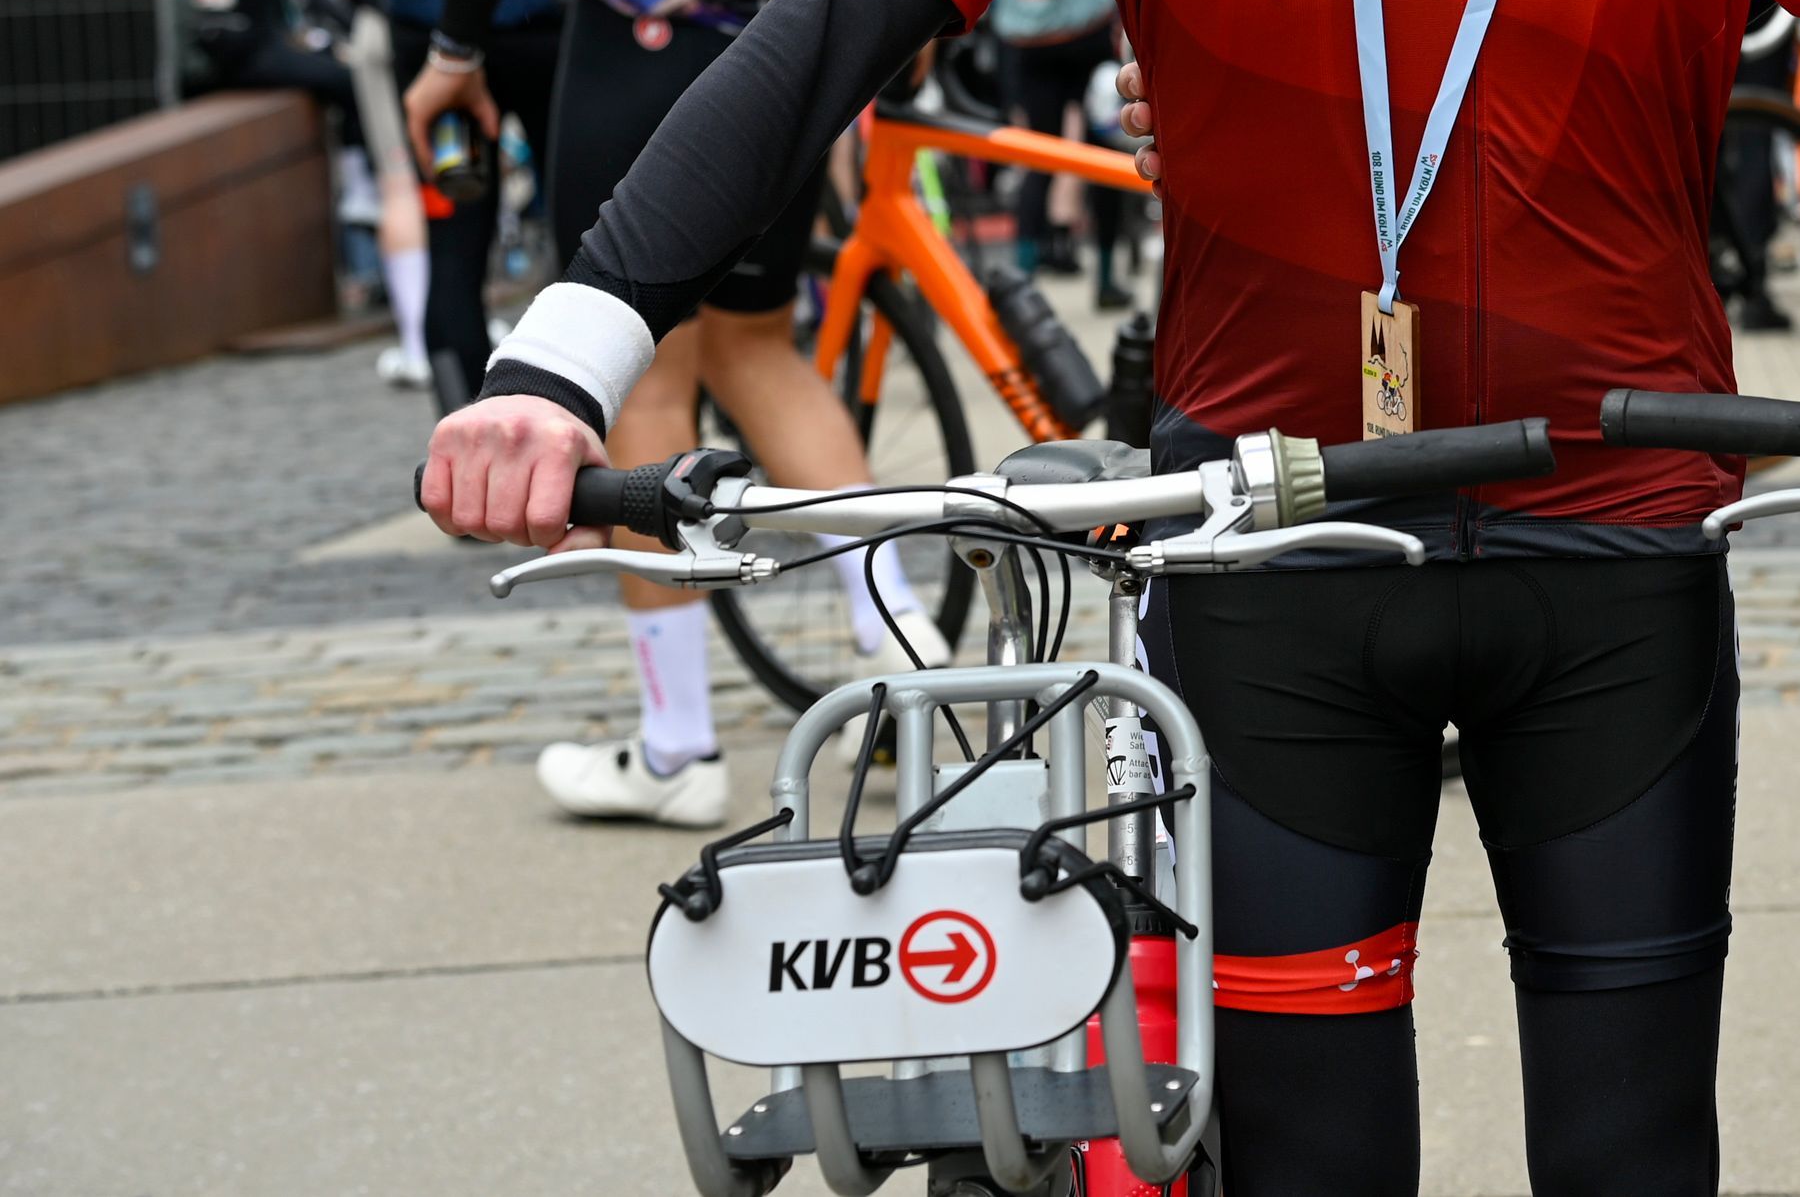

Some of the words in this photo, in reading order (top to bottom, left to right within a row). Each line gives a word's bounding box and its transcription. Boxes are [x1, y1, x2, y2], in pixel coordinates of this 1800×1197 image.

[1371, 150, 1382, 170] 108.
[1373, 170, 1384, 195] RUND
[1376, 197, 1386, 211] UM
[1401, 207, 1416, 230] RUND
[1412, 192, 1424, 207] UM
[768, 937, 892, 993] KVB
